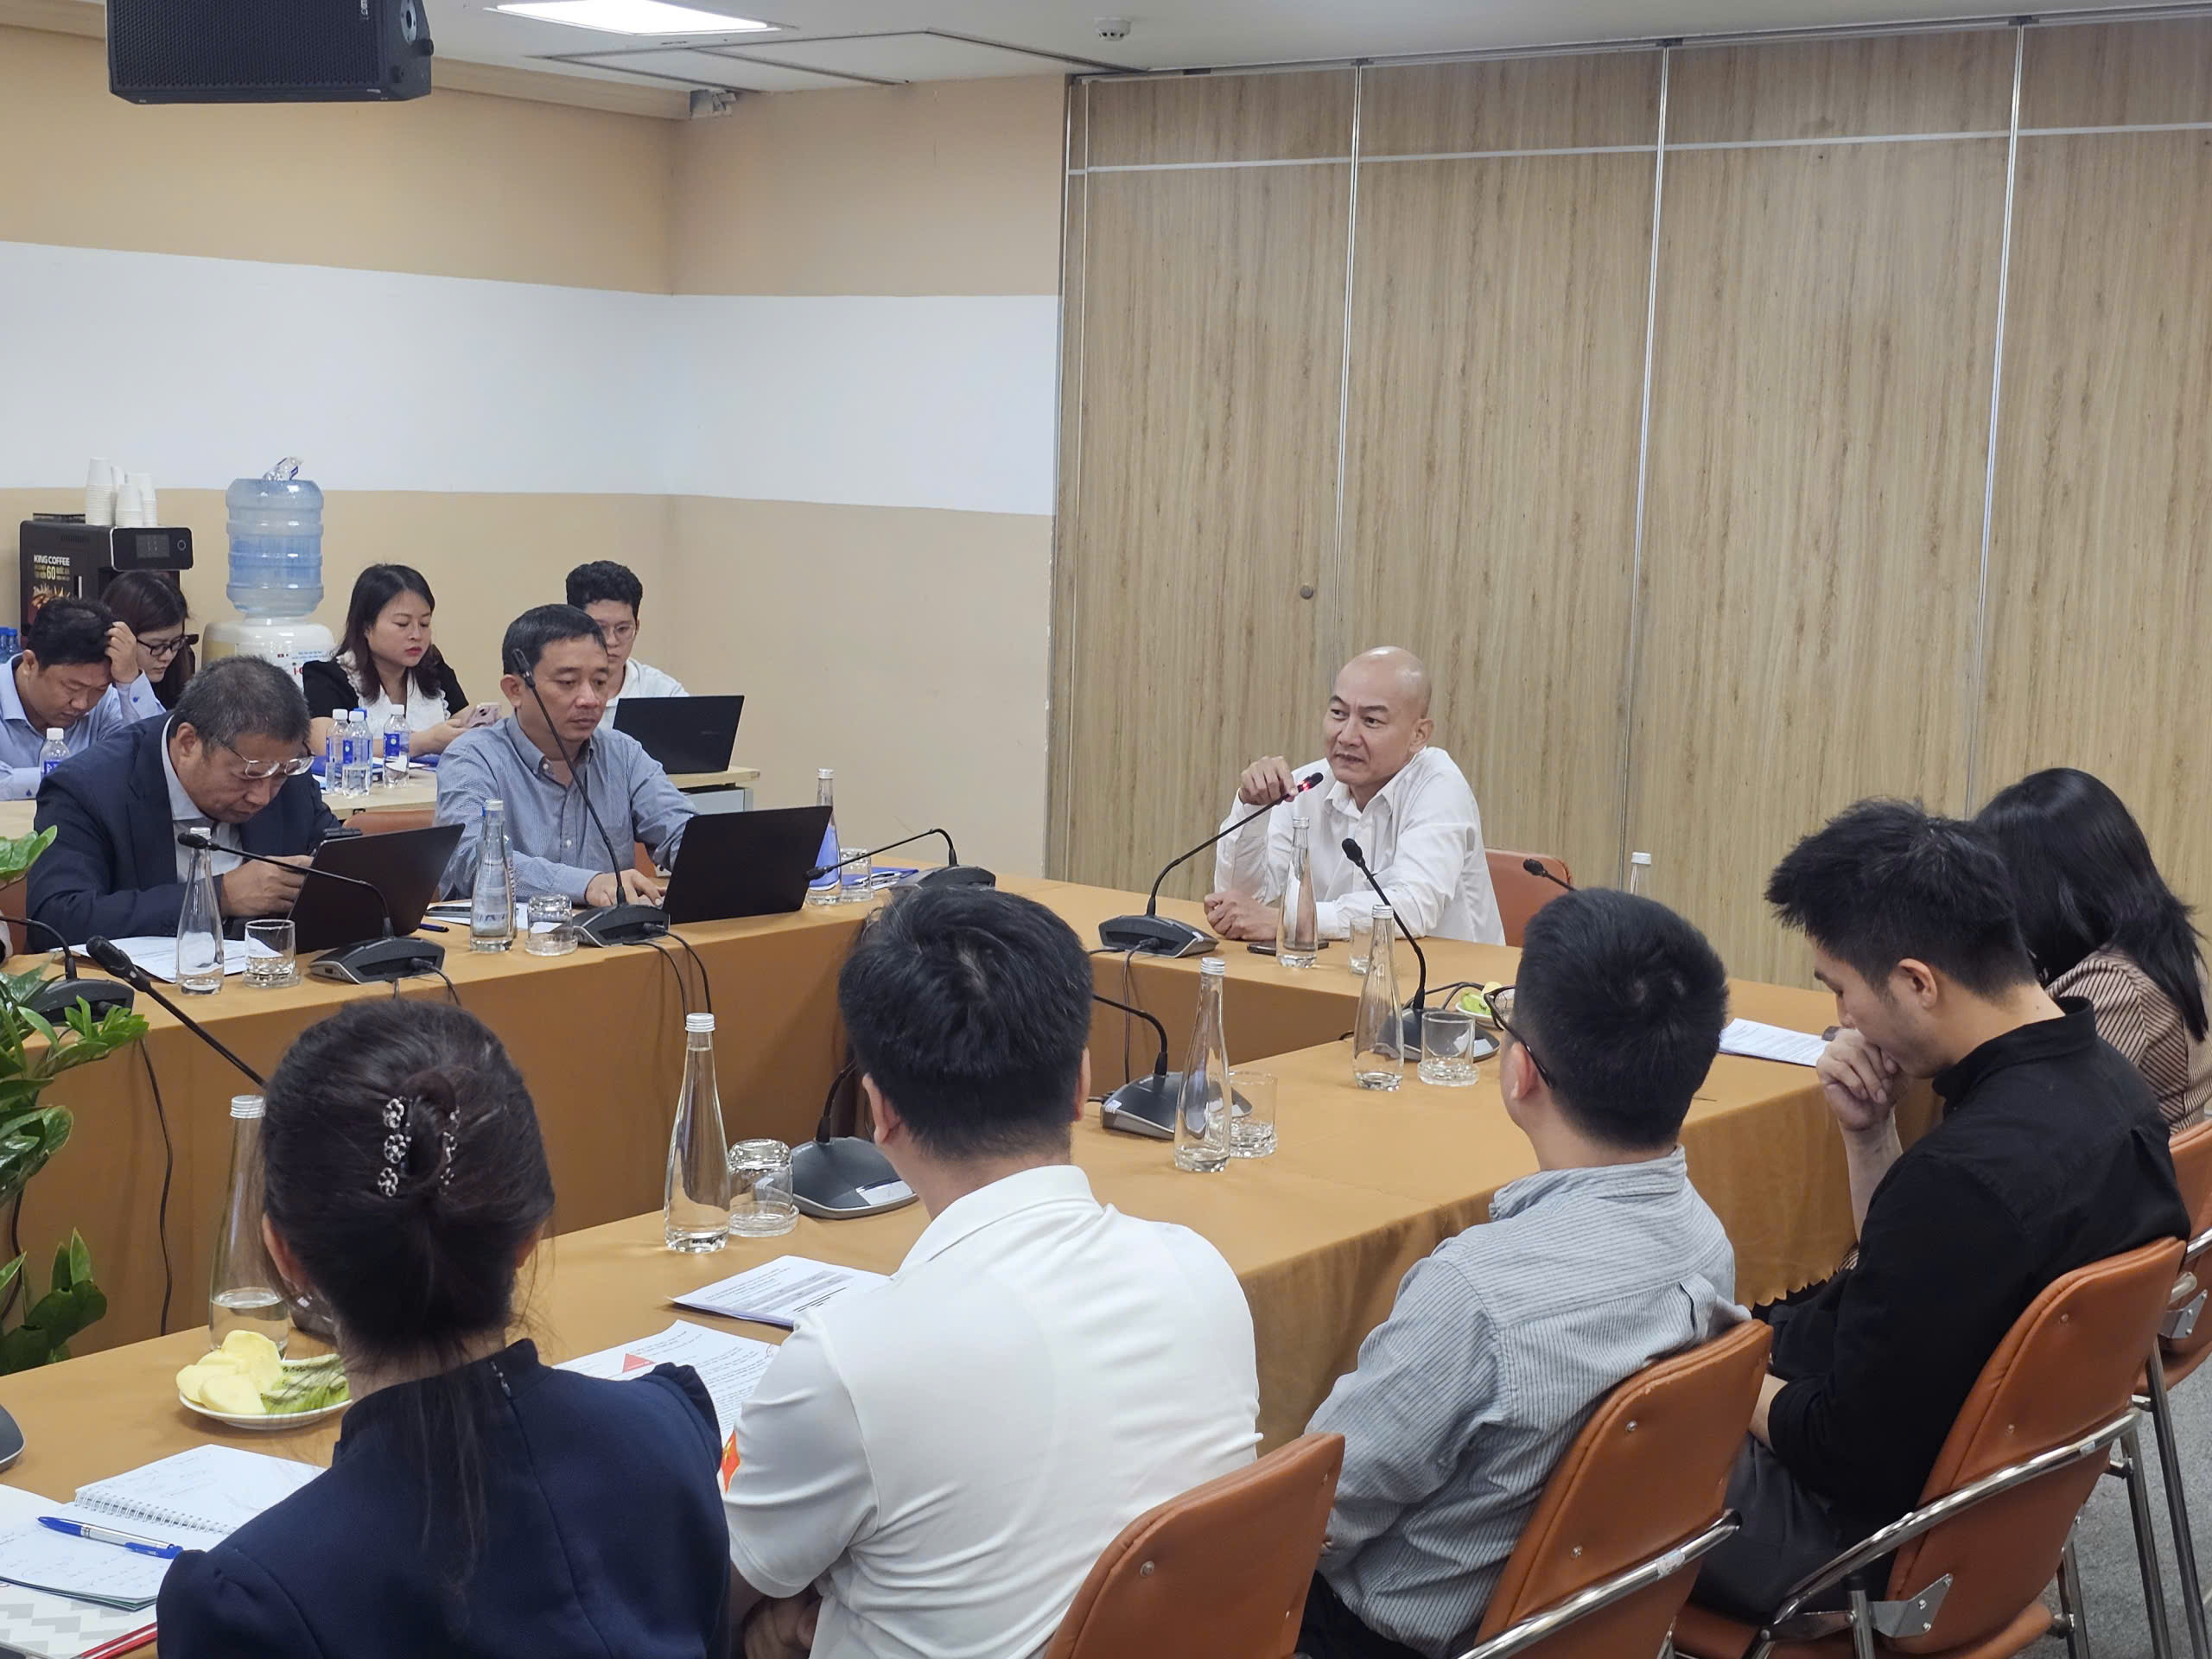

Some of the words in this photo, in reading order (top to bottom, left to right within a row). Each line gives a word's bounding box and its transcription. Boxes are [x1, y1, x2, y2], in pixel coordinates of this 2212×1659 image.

[34, 555, 48, 564] KING
[48, 556, 70, 566] COFFEE
[47, 566, 55, 580] 60
